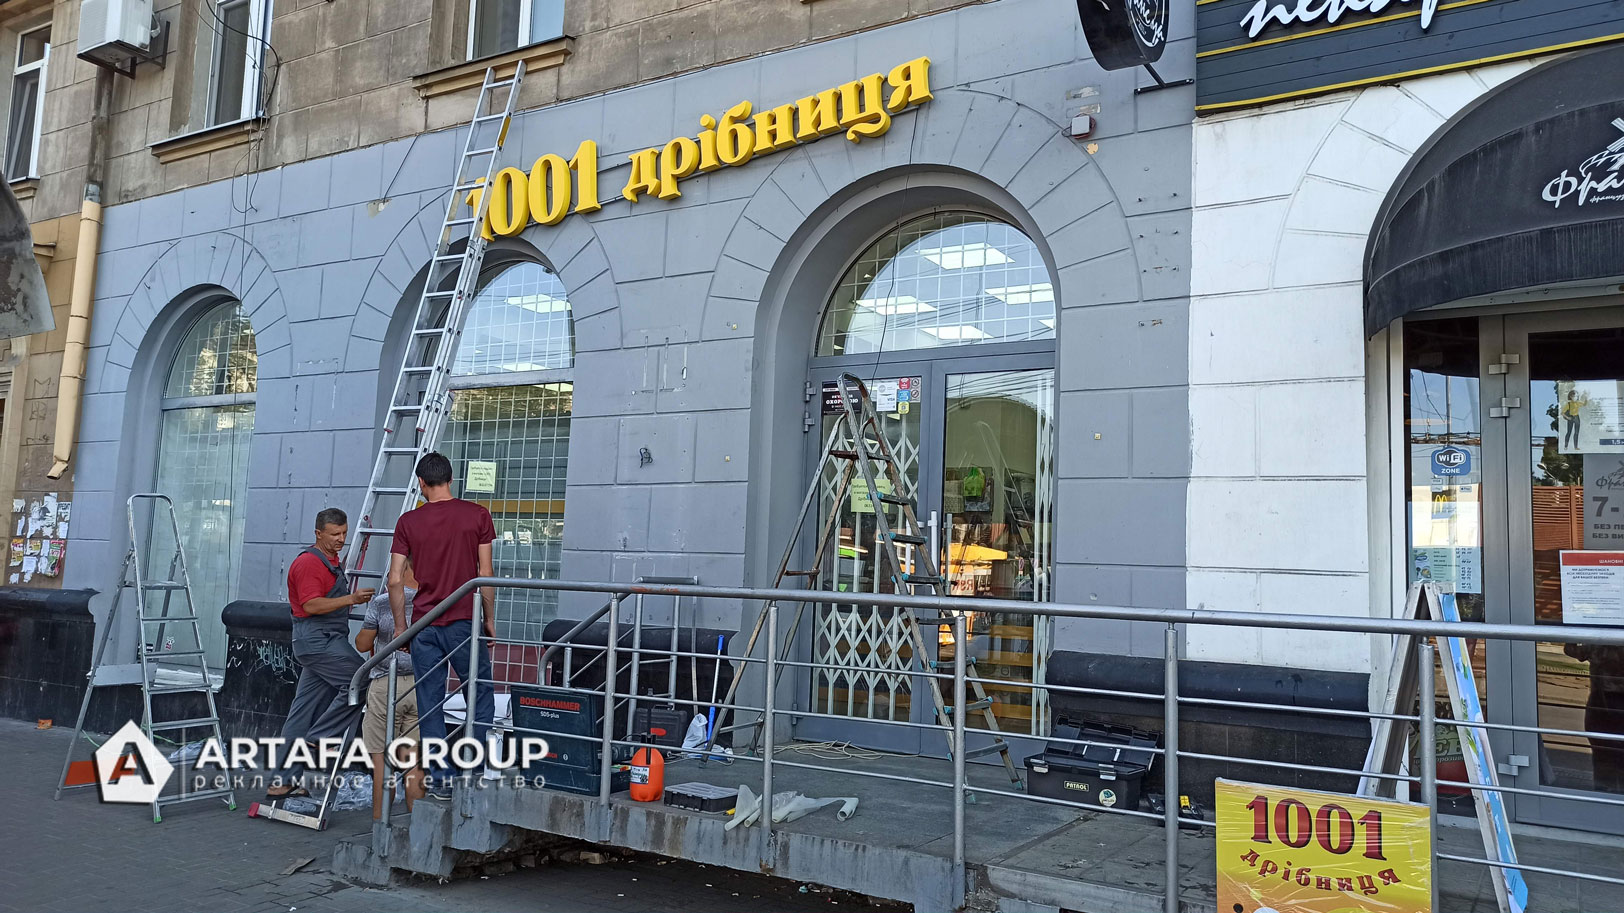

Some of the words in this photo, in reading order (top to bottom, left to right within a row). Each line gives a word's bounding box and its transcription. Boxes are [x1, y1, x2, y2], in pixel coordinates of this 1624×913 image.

[621, 55, 934, 203] дрібниця
[1246, 795, 1387, 861] 1001
[1240, 848, 1401, 895] дрібниця
